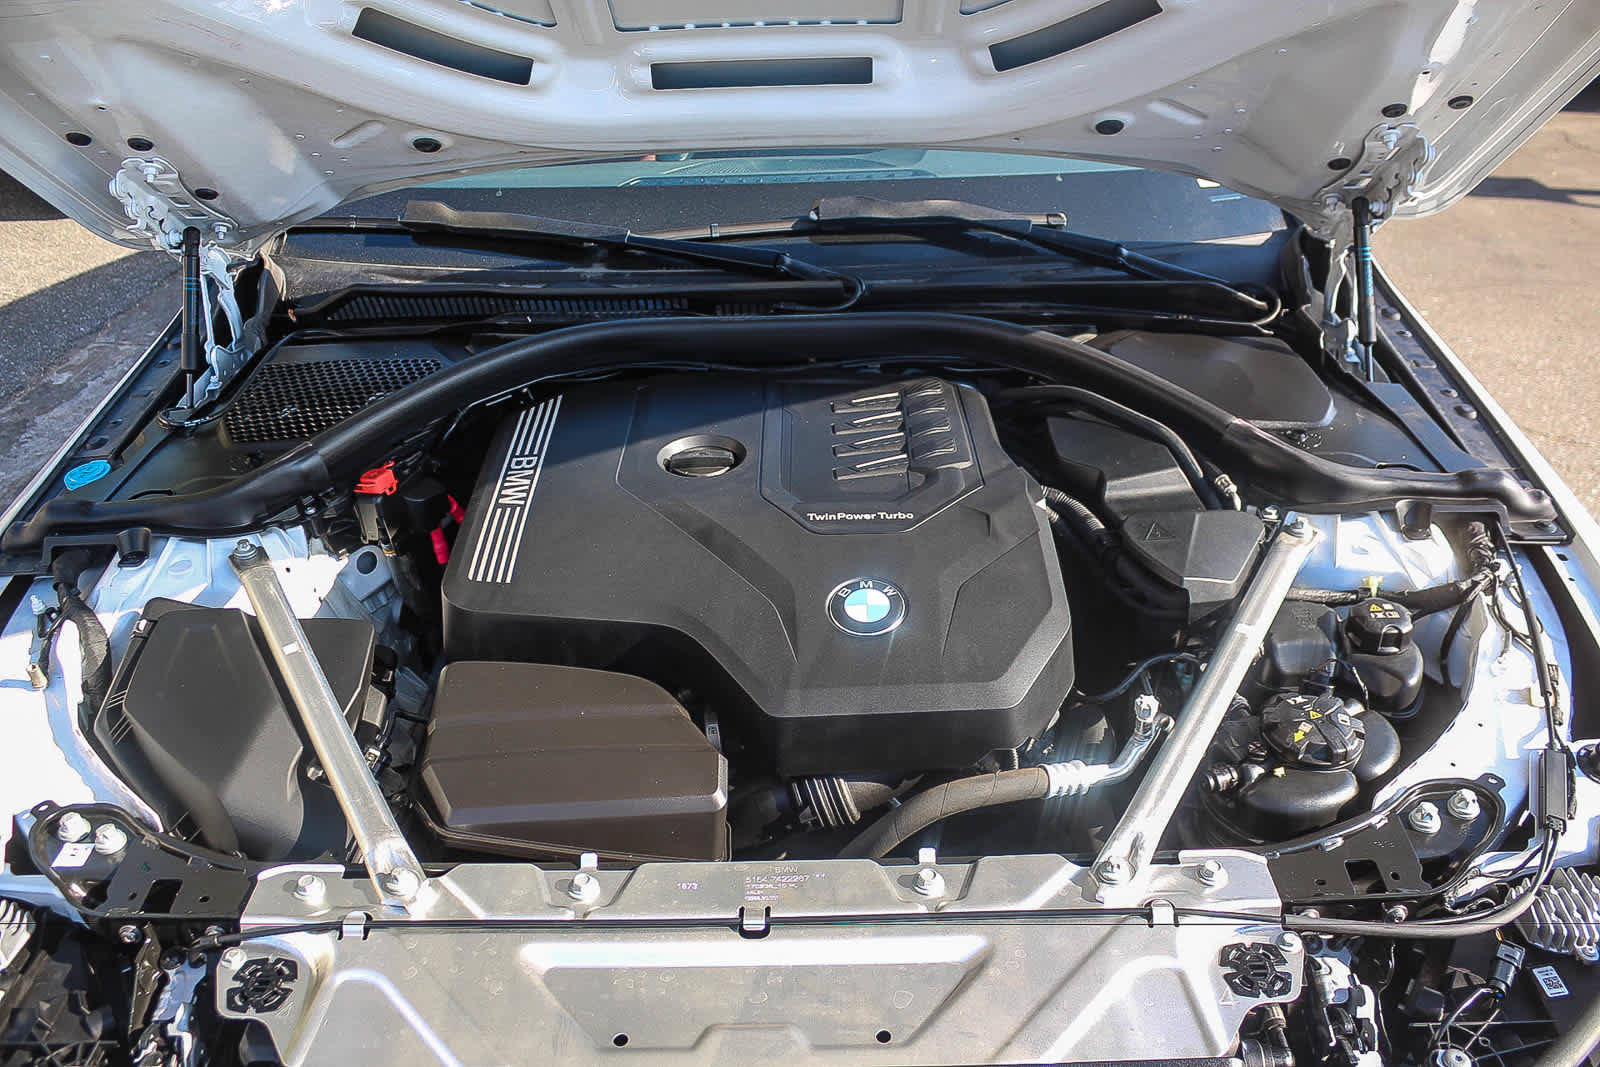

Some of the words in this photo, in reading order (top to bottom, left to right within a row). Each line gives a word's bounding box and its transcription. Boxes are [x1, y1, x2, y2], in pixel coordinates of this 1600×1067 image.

[498, 456, 538, 505] BMW
[877, 511, 914, 520] Turbo
[838, 580, 898, 599] BMW
[774, 865, 799, 873] BMW
